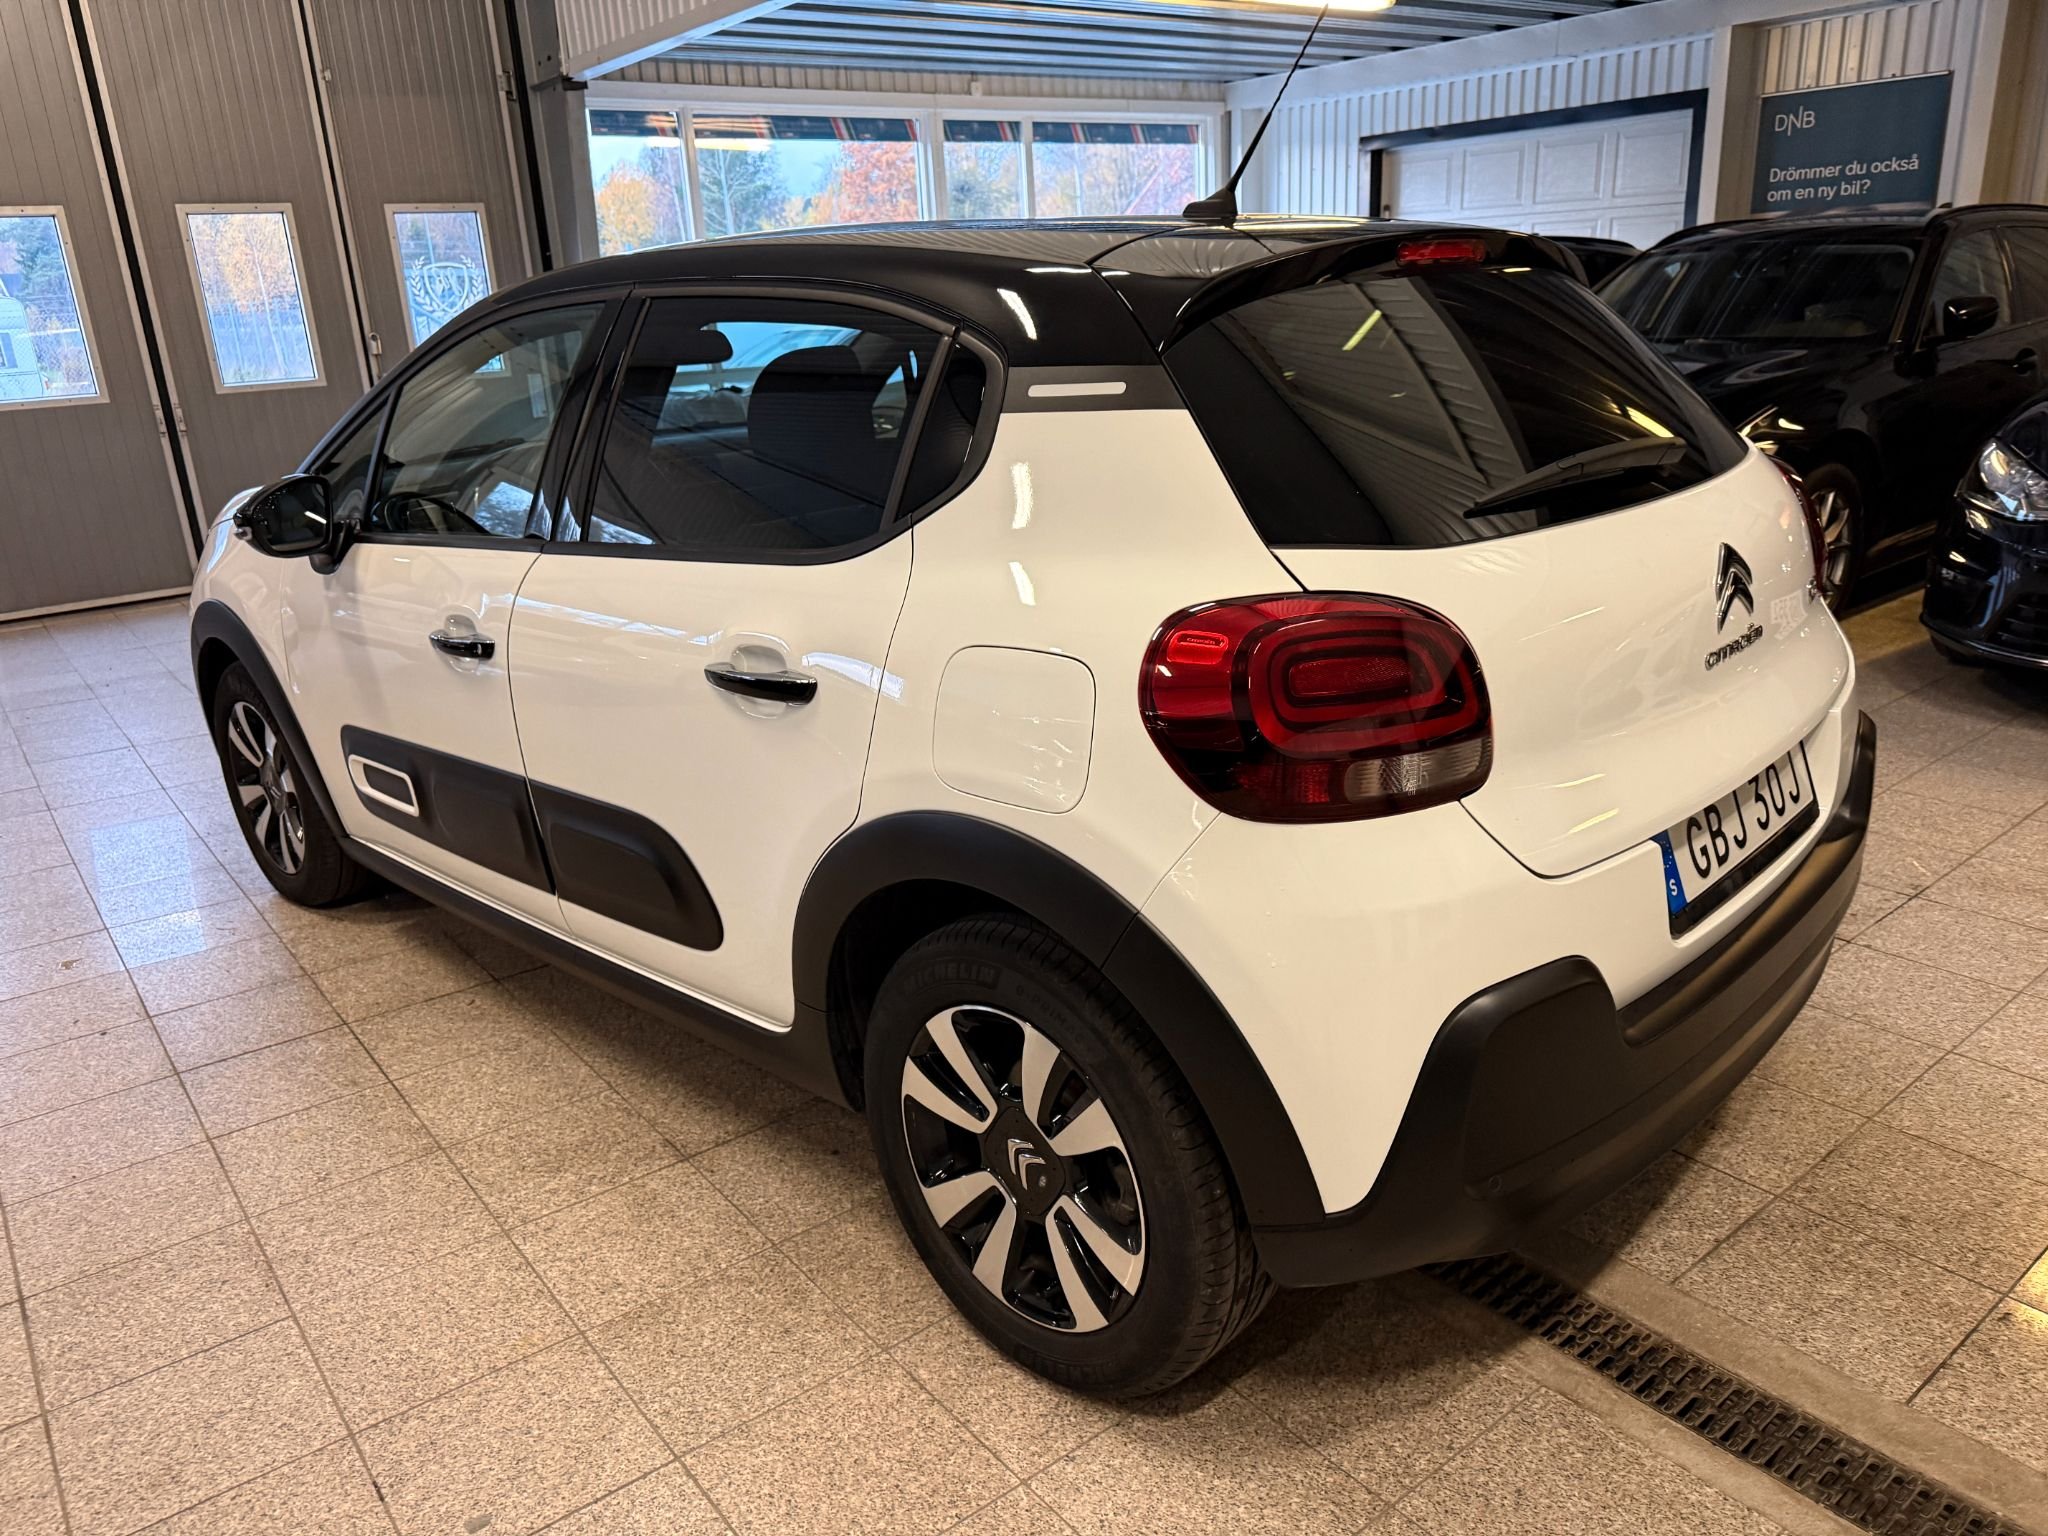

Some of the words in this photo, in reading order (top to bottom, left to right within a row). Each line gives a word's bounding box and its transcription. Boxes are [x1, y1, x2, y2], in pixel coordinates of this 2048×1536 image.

[1774, 105, 1816, 136] DNB
[1769, 163, 1841, 183] Drömmer
[1845, 160, 1867, 175] du
[1871, 153, 1919, 173] också
[1767, 189, 1791, 202] om
[1795, 188, 1813, 199] en
[1817, 186, 1836, 201] ny
[1841, 179, 1871, 196] bil?
[1686, 789, 1747, 879] GBJ
[1748, 750, 1800, 831] 30J
[1669, 878, 1678, 896] S
[904, 961, 1000, 994] MICHELIN
